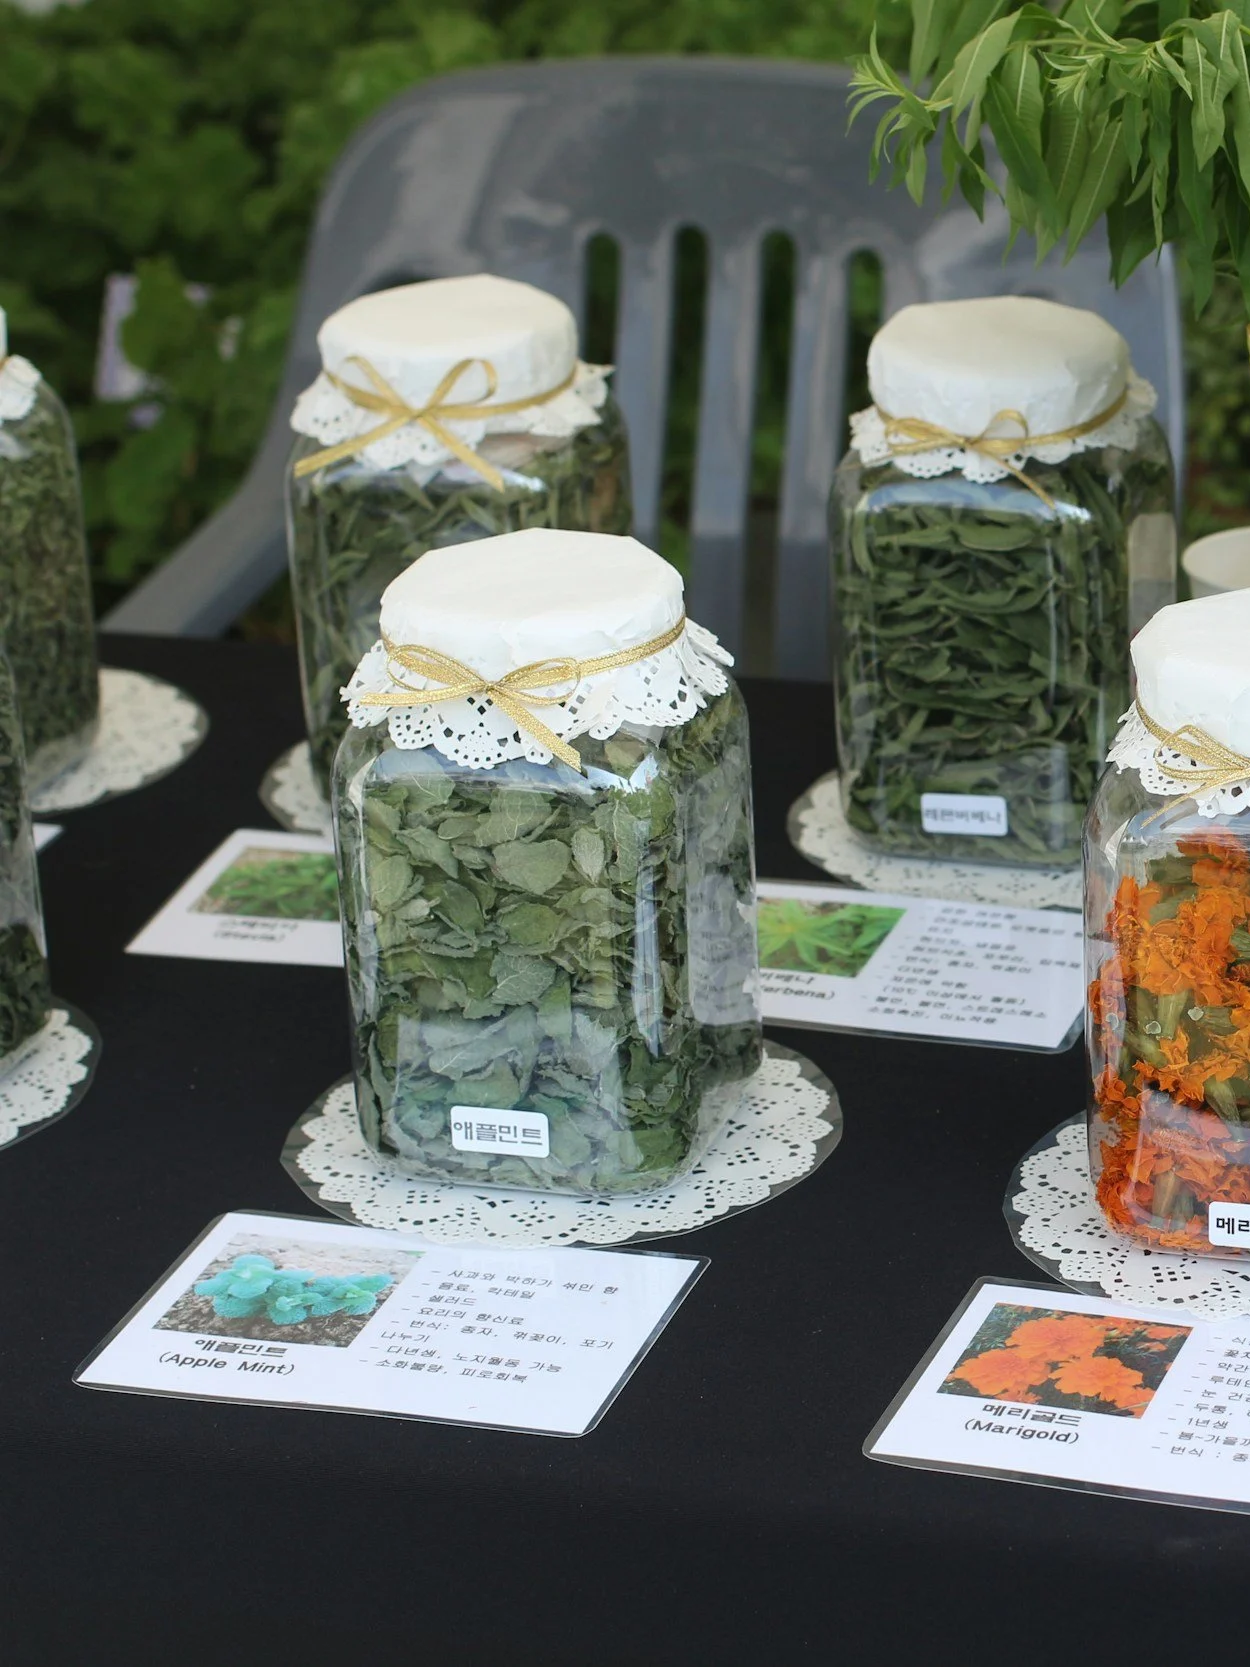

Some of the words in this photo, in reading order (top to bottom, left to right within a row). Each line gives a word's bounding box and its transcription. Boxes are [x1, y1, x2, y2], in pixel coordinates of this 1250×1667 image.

[454, 1121, 542, 1145] 애플민트
[438, 1281, 476, 1293] 음료,
[448, 1269, 495, 1281] 사과와
[506, 1275, 553, 1288] 박하가
[428, 1294, 477, 1306] 샐러드
[418, 1307, 466, 1319] 요리의
[475, 1313, 525, 1325] 향신료
[381, 1330, 431, 1343] 나누기
[410, 1320, 449, 1331] 번식:
[580, 1338, 615, 1350] 포기
[195, 1339, 288, 1357] 애플민트
[159, 1351, 227, 1368] (Apple
[237, 1361, 295, 1375] Mint)
[386, 1345, 441, 1359] 다년생,
[529, 1361, 563, 1373] 가능
[1217, 1362, 1250, 1373] 약간
[459, 1367, 528, 1384] 피로회복
[1201, 1389, 1217, 1398] 눈
[982, 1404, 1082, 1426] 메리골드
[965, 1418, 1079, 1444] (Marigold)
[1170, 1446, 1204, 1457] 번식
